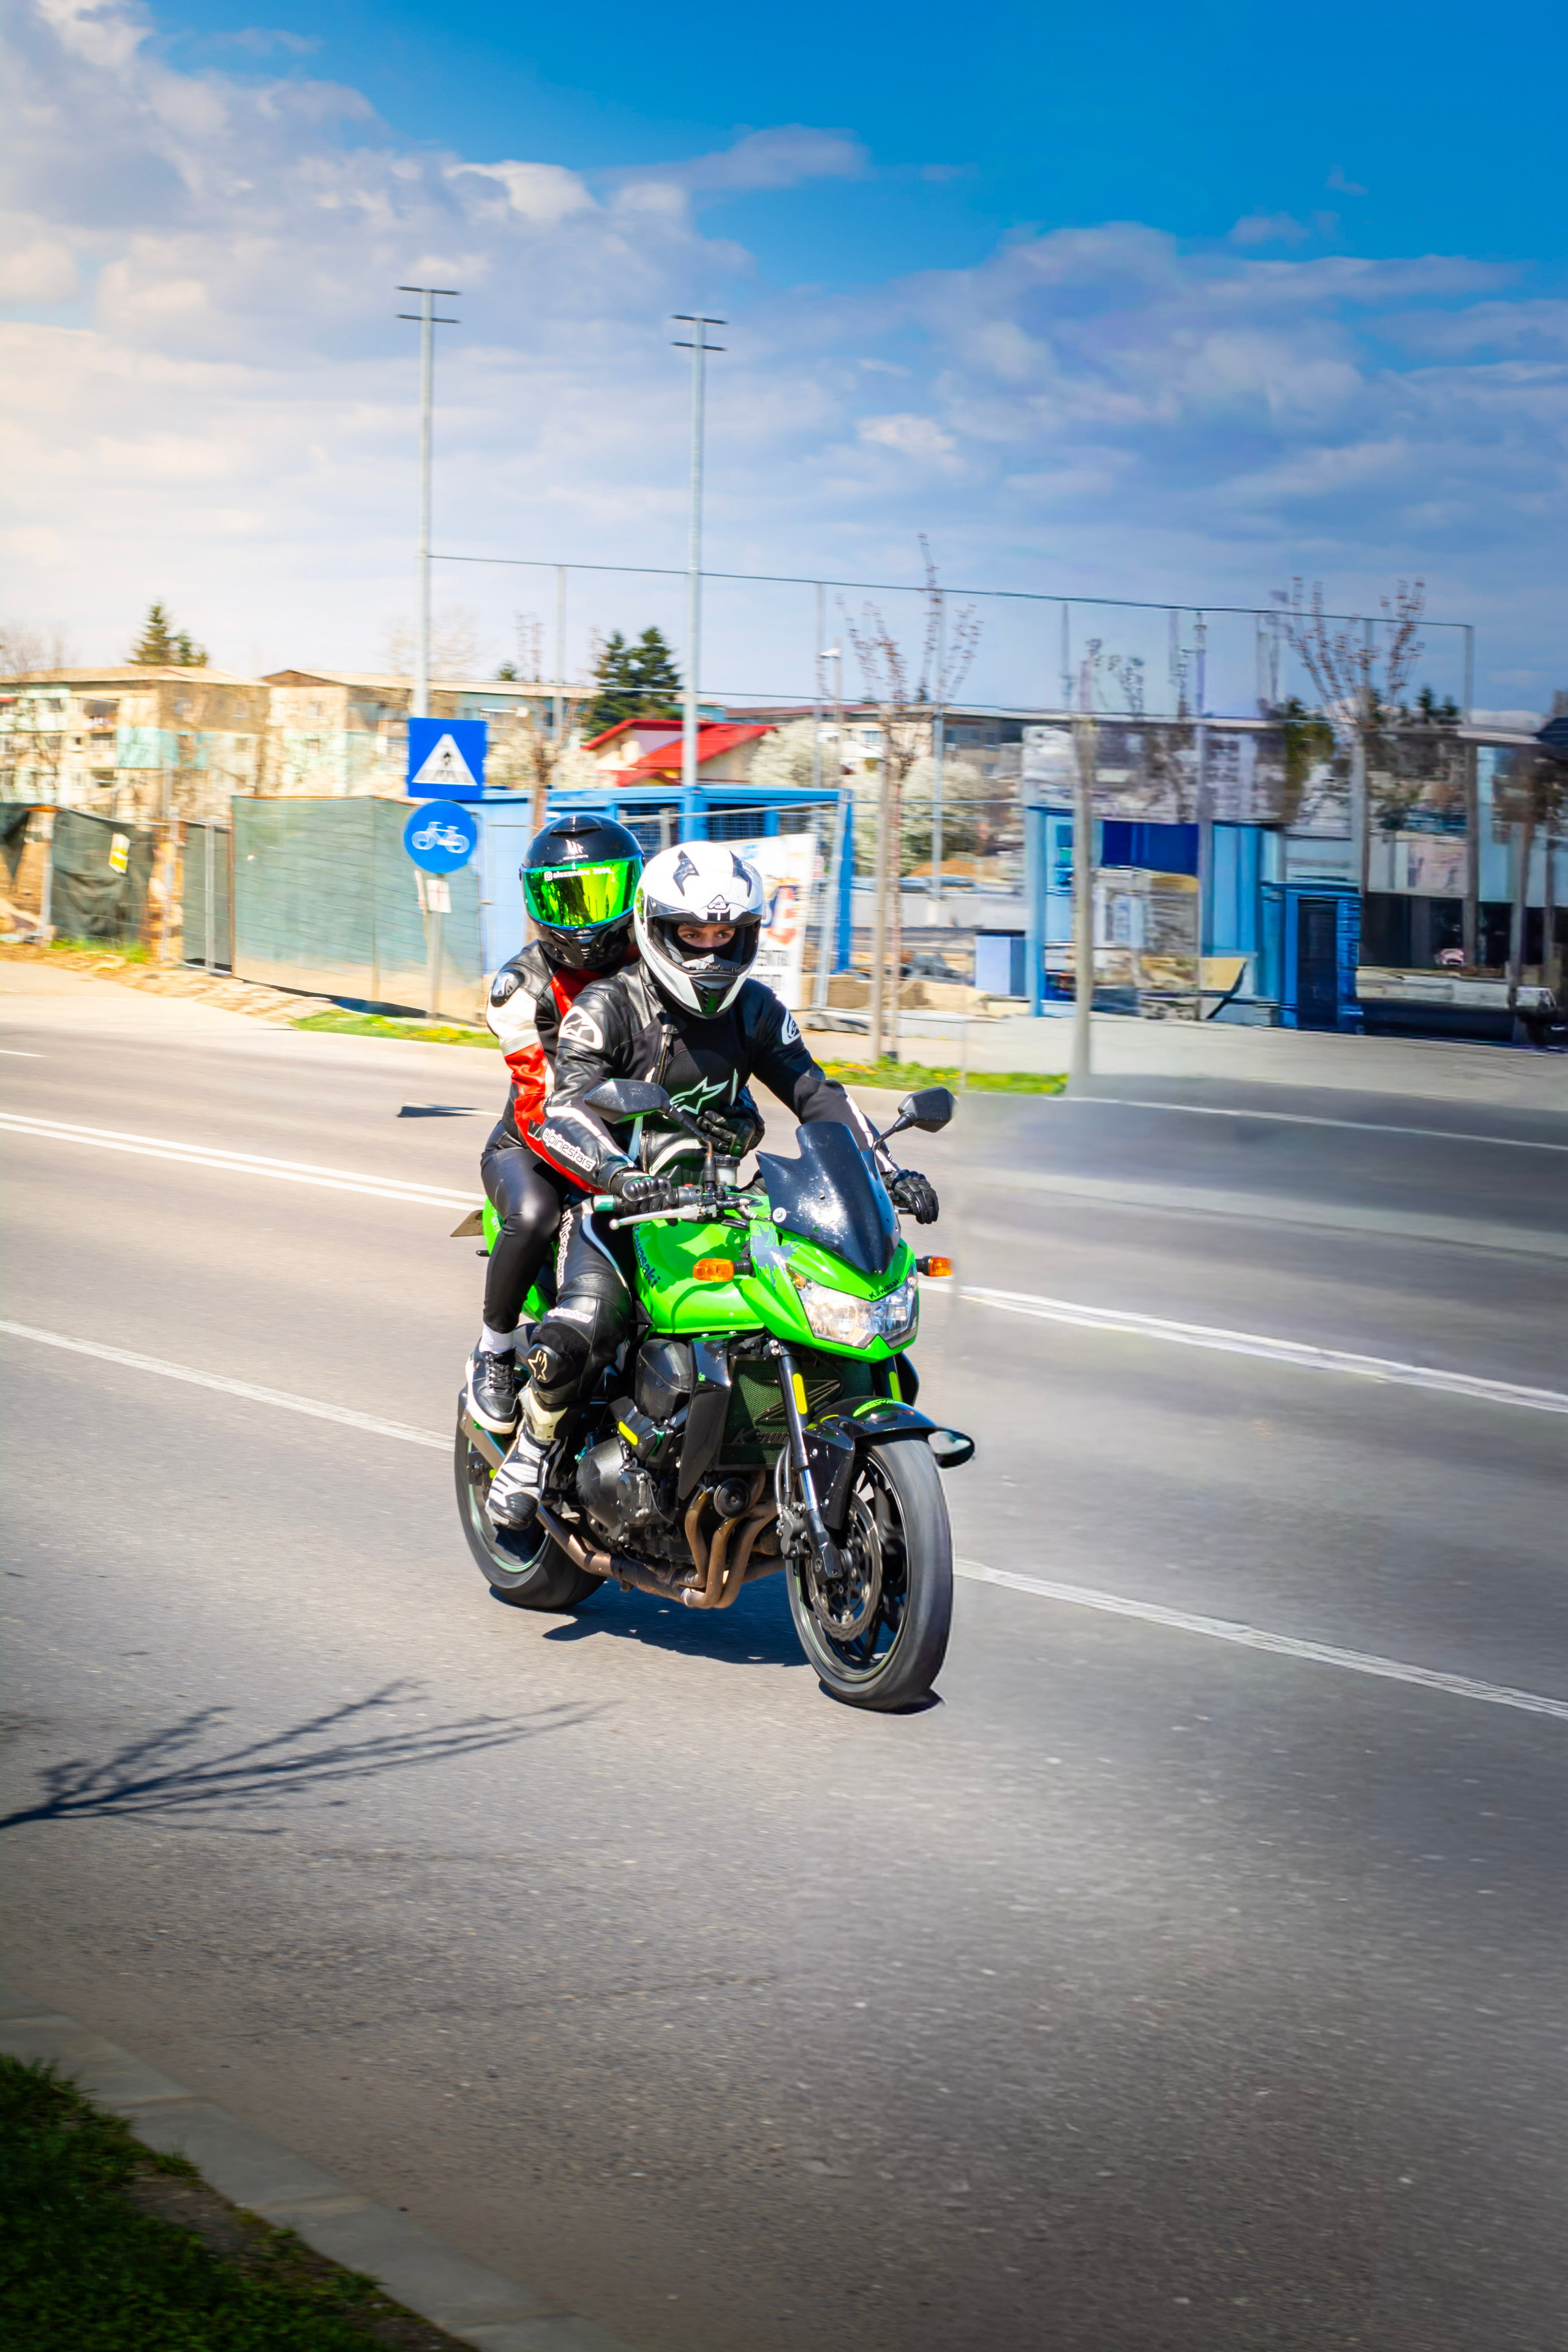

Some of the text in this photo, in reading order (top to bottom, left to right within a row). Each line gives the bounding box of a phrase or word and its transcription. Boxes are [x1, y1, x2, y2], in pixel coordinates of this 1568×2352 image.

[552, 869, 590, 879] alexandru
[542, 1128, 596, 1171] alpinestars
[869, 1277, 902, 1300] Kawasaki
